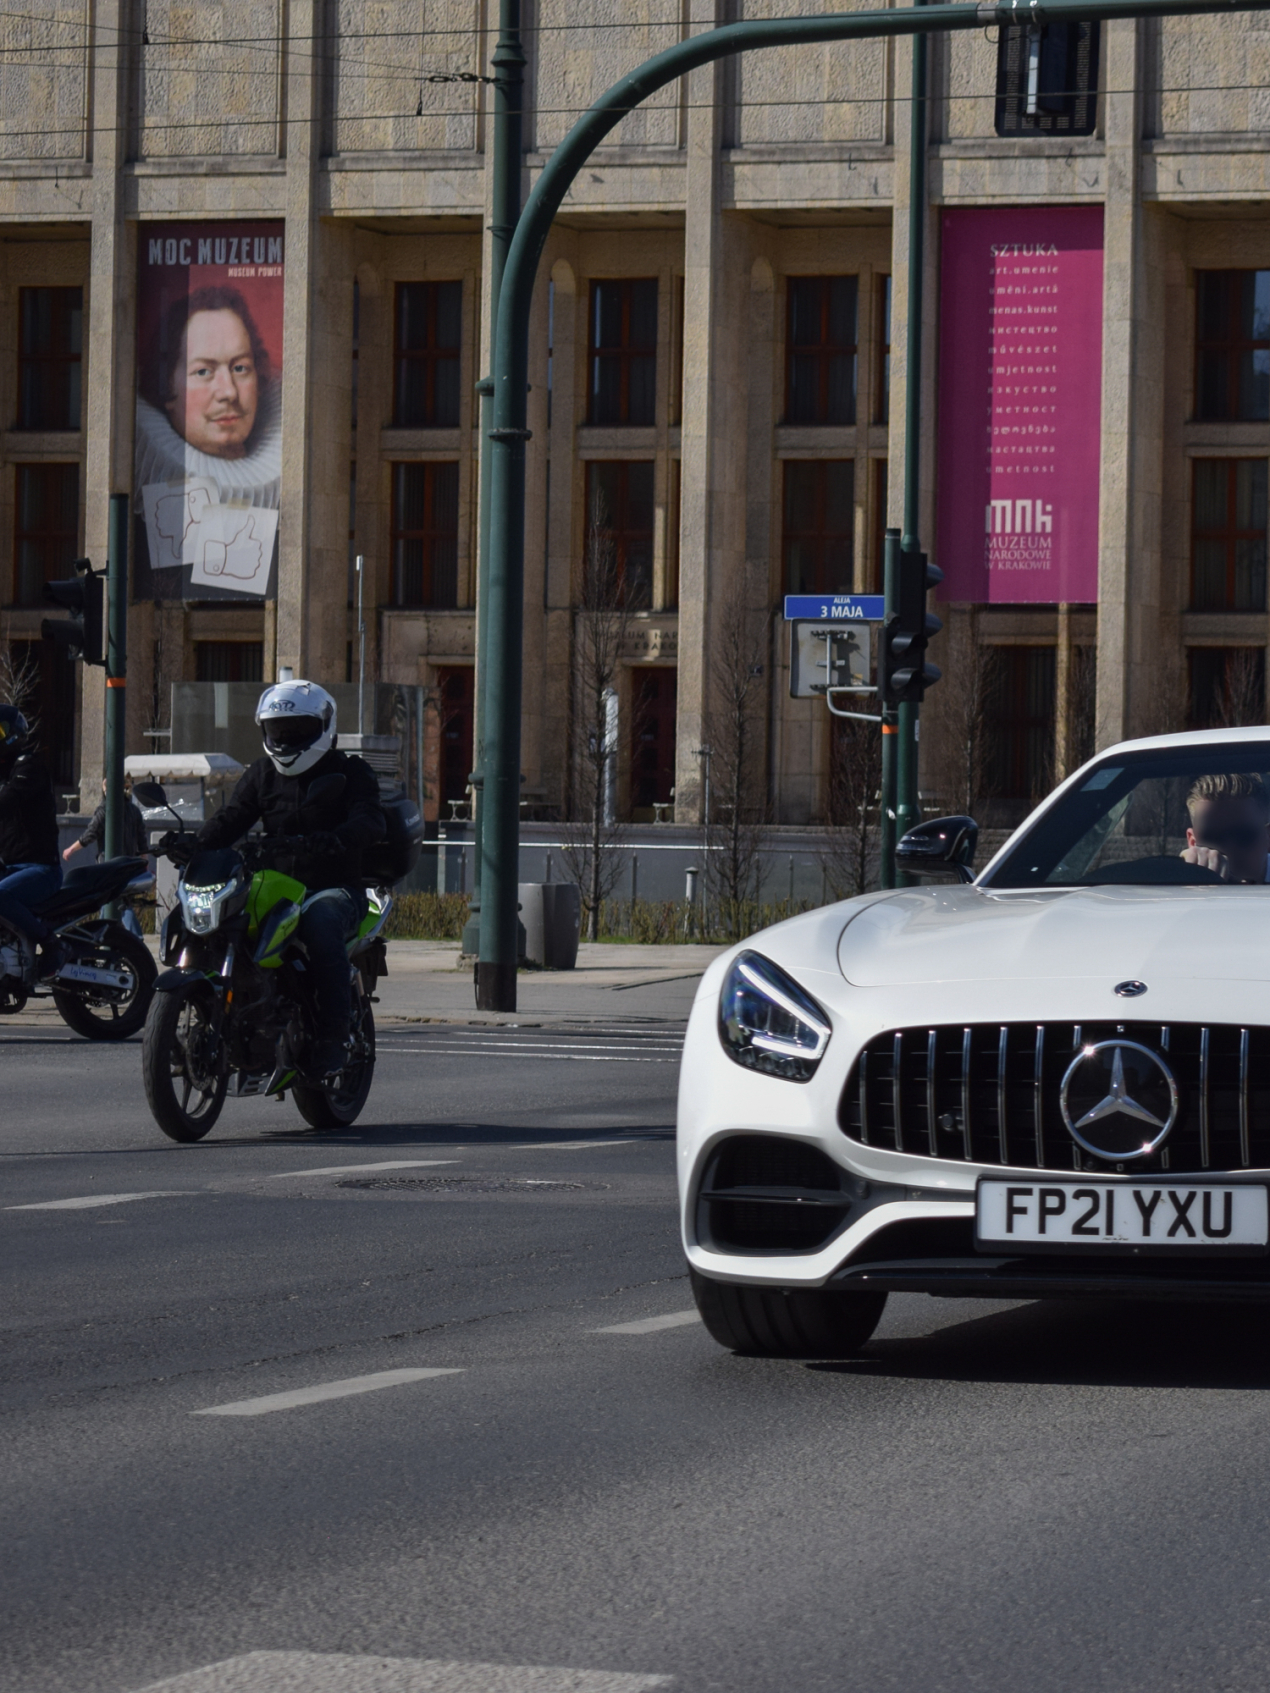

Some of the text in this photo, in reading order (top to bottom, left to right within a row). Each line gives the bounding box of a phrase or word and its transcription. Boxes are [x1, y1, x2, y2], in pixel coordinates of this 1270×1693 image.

[148, 236, 283, 266] MOC MUZEUM
[989, 243, 1059, 257] SZTUKA
[228, 266, 283, 278] MUSEUM POWER
[984, 536, 1052, 549] MUZEUM
[984, 549, 1052, 560] NARODOWE
[997, 561, 1051, 570] KRAKOWIE
[820, 606, 864, 618] 3 MAJA
[1006, 1187, 1233, 1238] FP21 YXU
